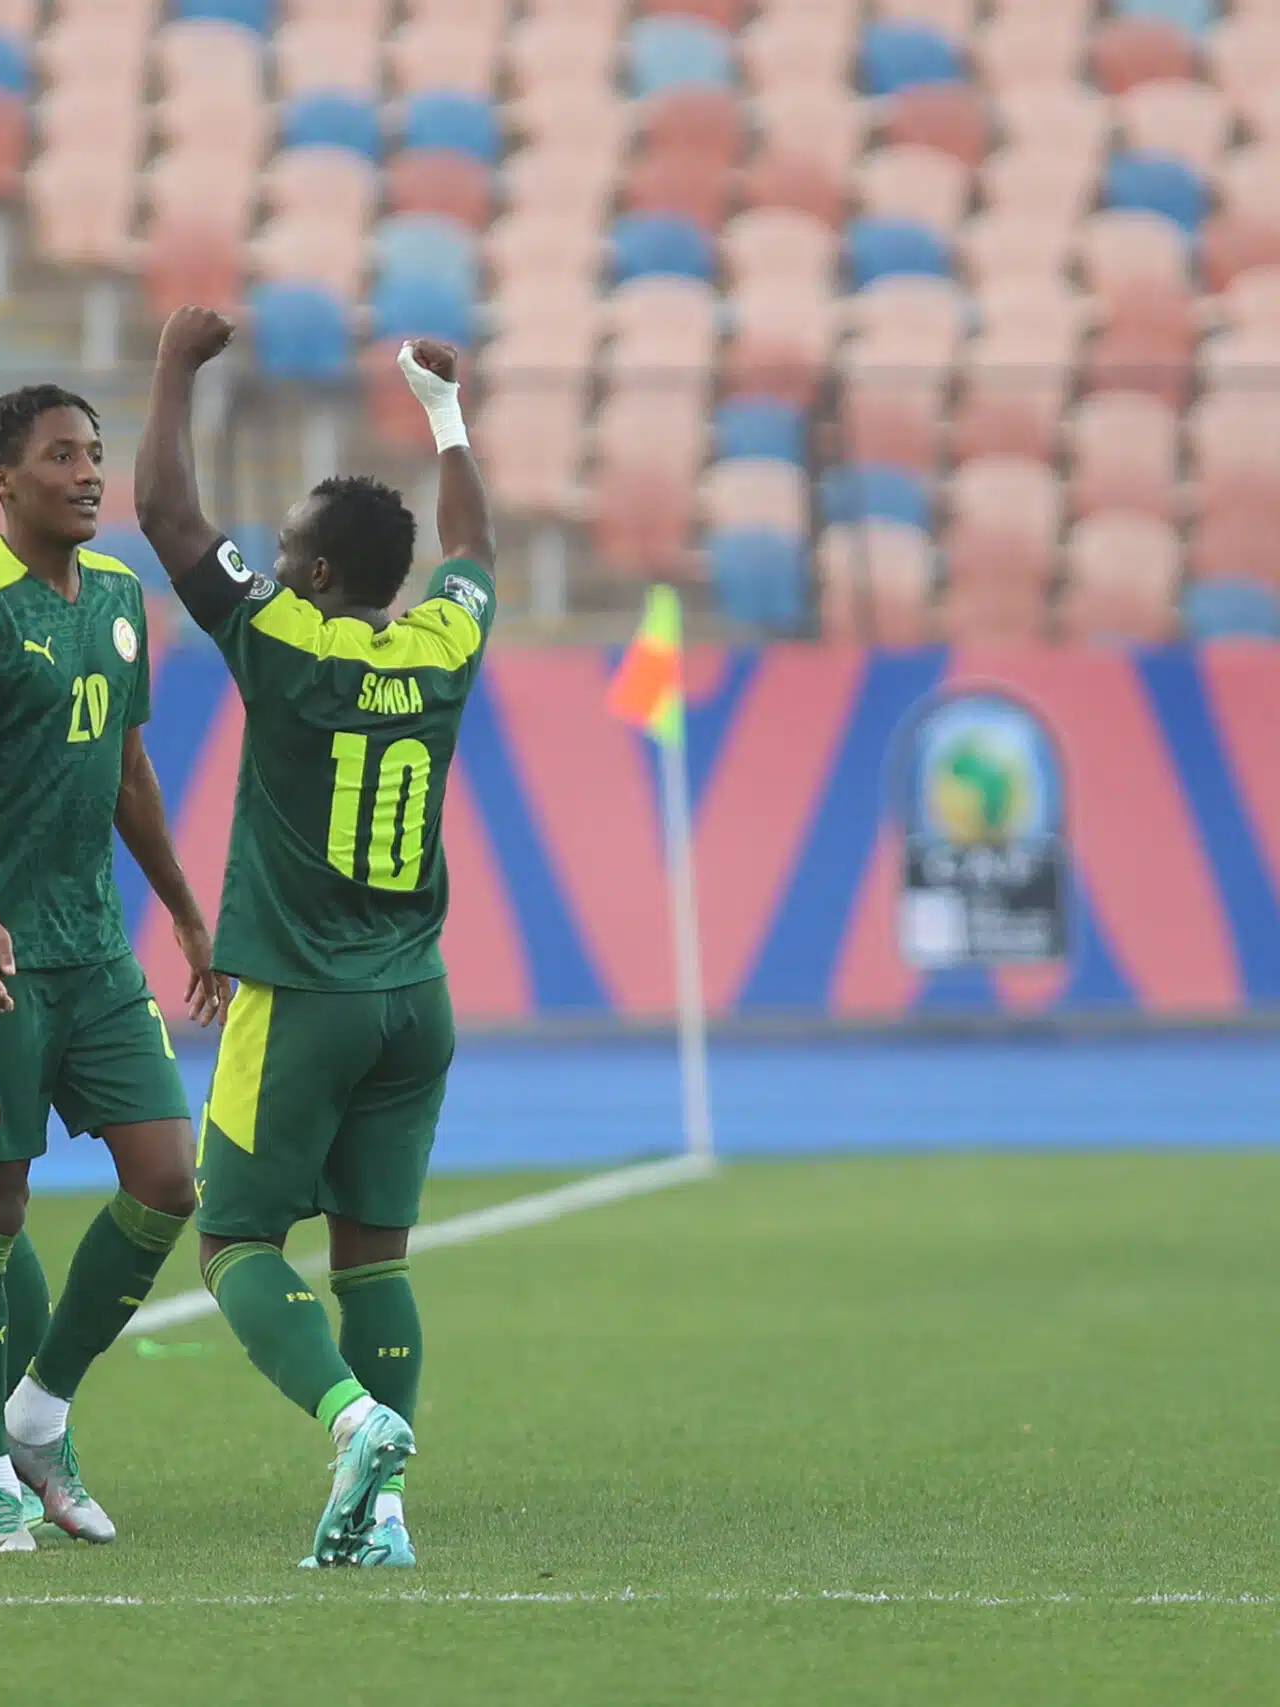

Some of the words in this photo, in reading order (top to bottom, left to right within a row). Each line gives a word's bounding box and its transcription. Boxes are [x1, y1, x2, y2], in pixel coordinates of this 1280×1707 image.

[67, 673, 109, 743] 20
[358, 672, 423, 715] SAMBA
[327, 731, 431, 891] 10
[377, 1347, 411, 1358] FSF
